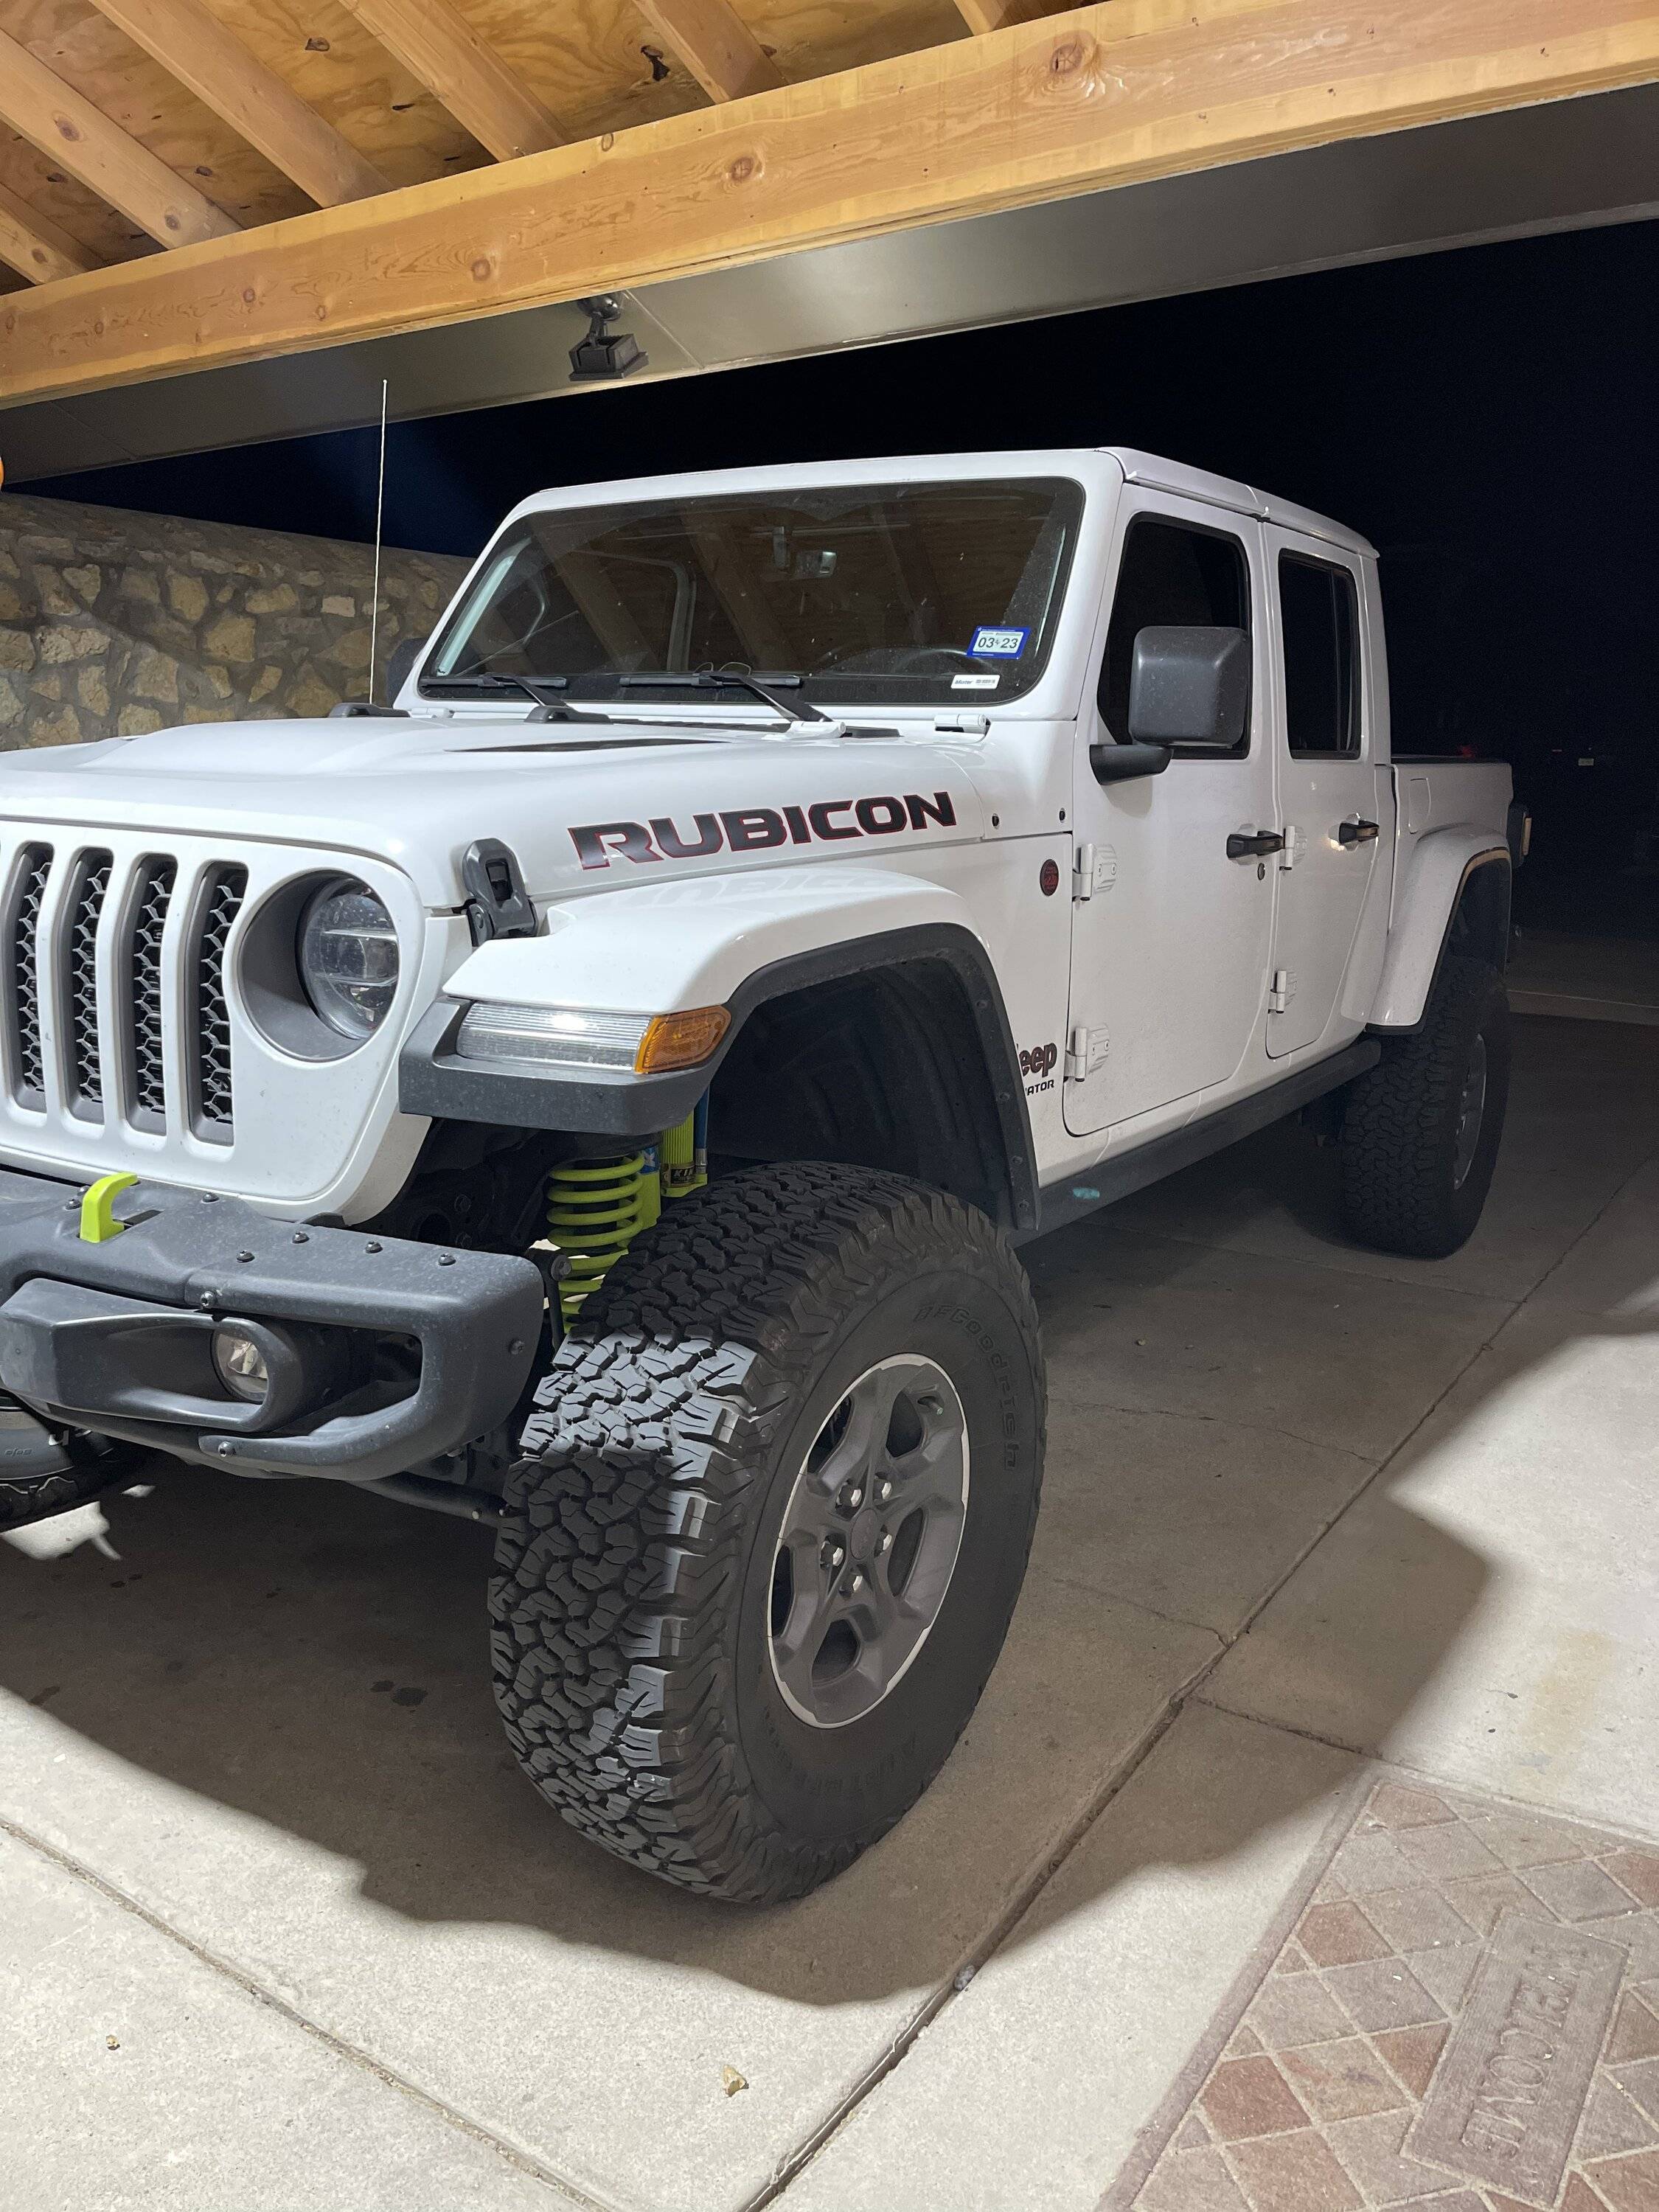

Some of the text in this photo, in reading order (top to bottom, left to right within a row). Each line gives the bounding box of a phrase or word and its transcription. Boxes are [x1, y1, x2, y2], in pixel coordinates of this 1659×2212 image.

[567, 791, 957, 870] RUBICON
[1017, 1043, 1057, 1078] eep
[1026, 1079, 1054, 1096] ATOR
